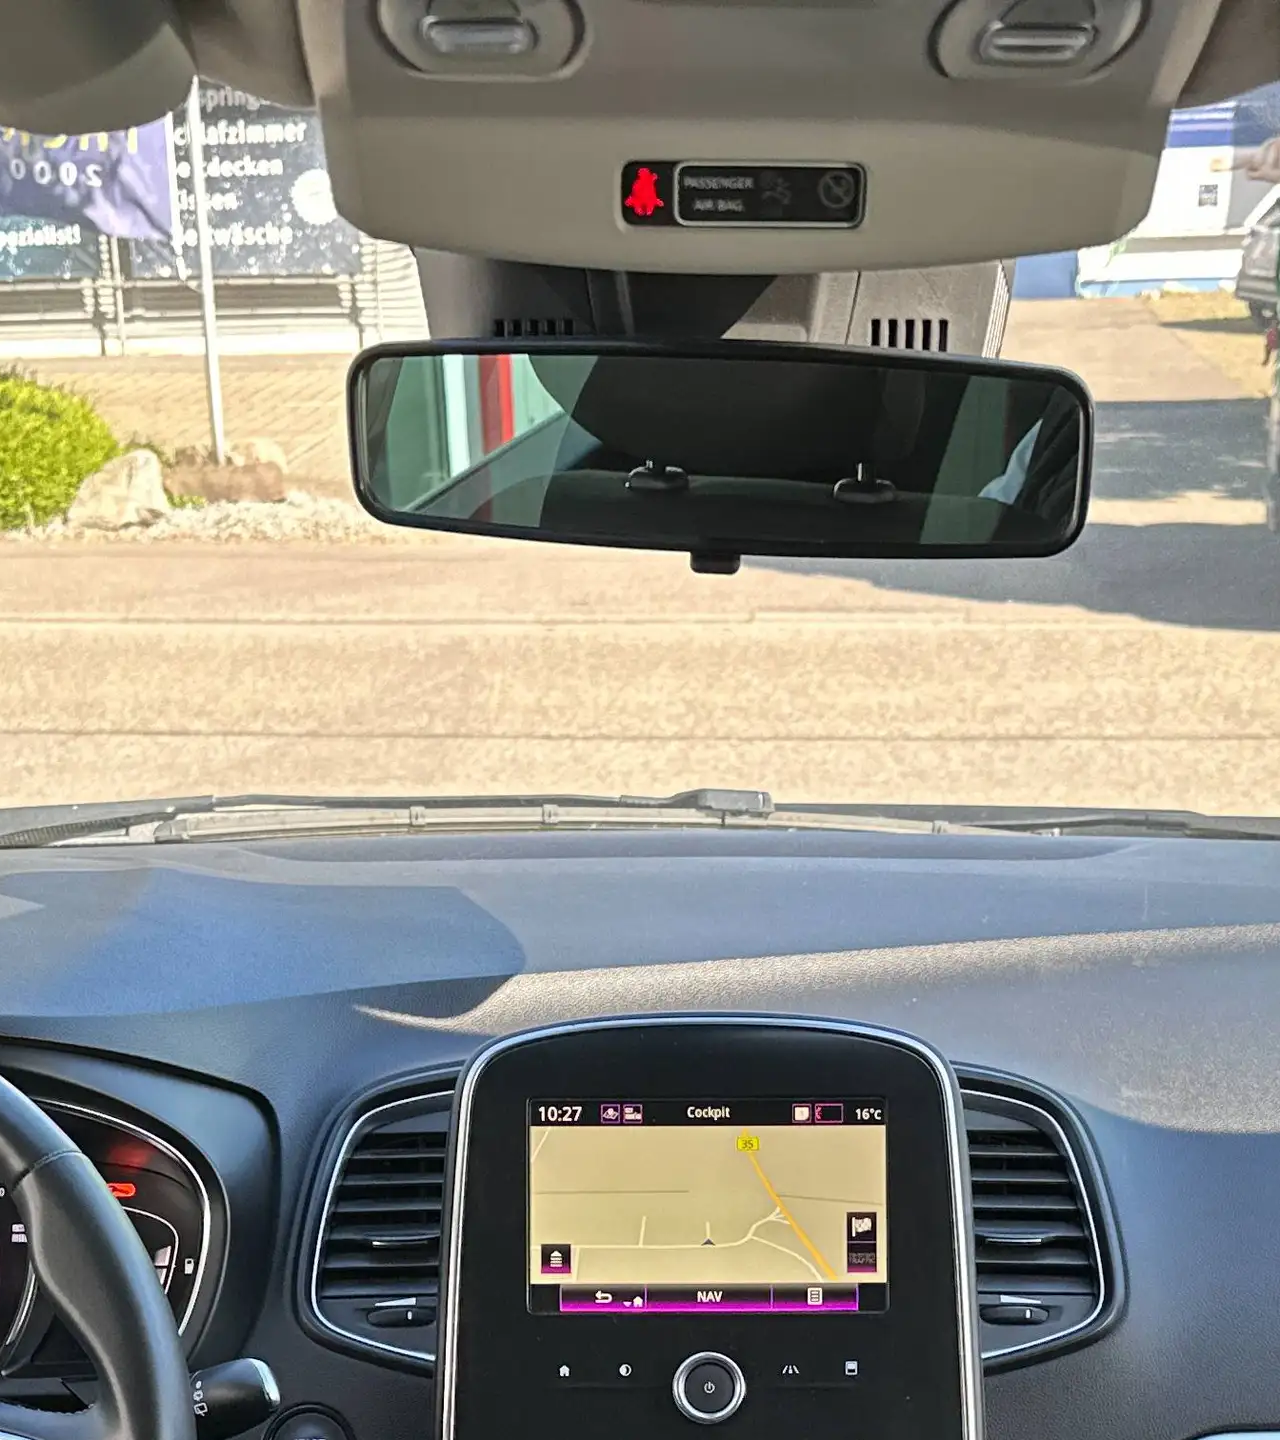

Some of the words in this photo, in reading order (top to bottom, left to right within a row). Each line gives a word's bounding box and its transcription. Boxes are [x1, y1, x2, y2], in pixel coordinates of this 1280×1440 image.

[538, 1106, 583, 1122] 10:27
[687, 1106, 731, 1121] Cockpit
[741, 1139, 754, 1149] 35
[697, 1291, 723, 1303] NAV
